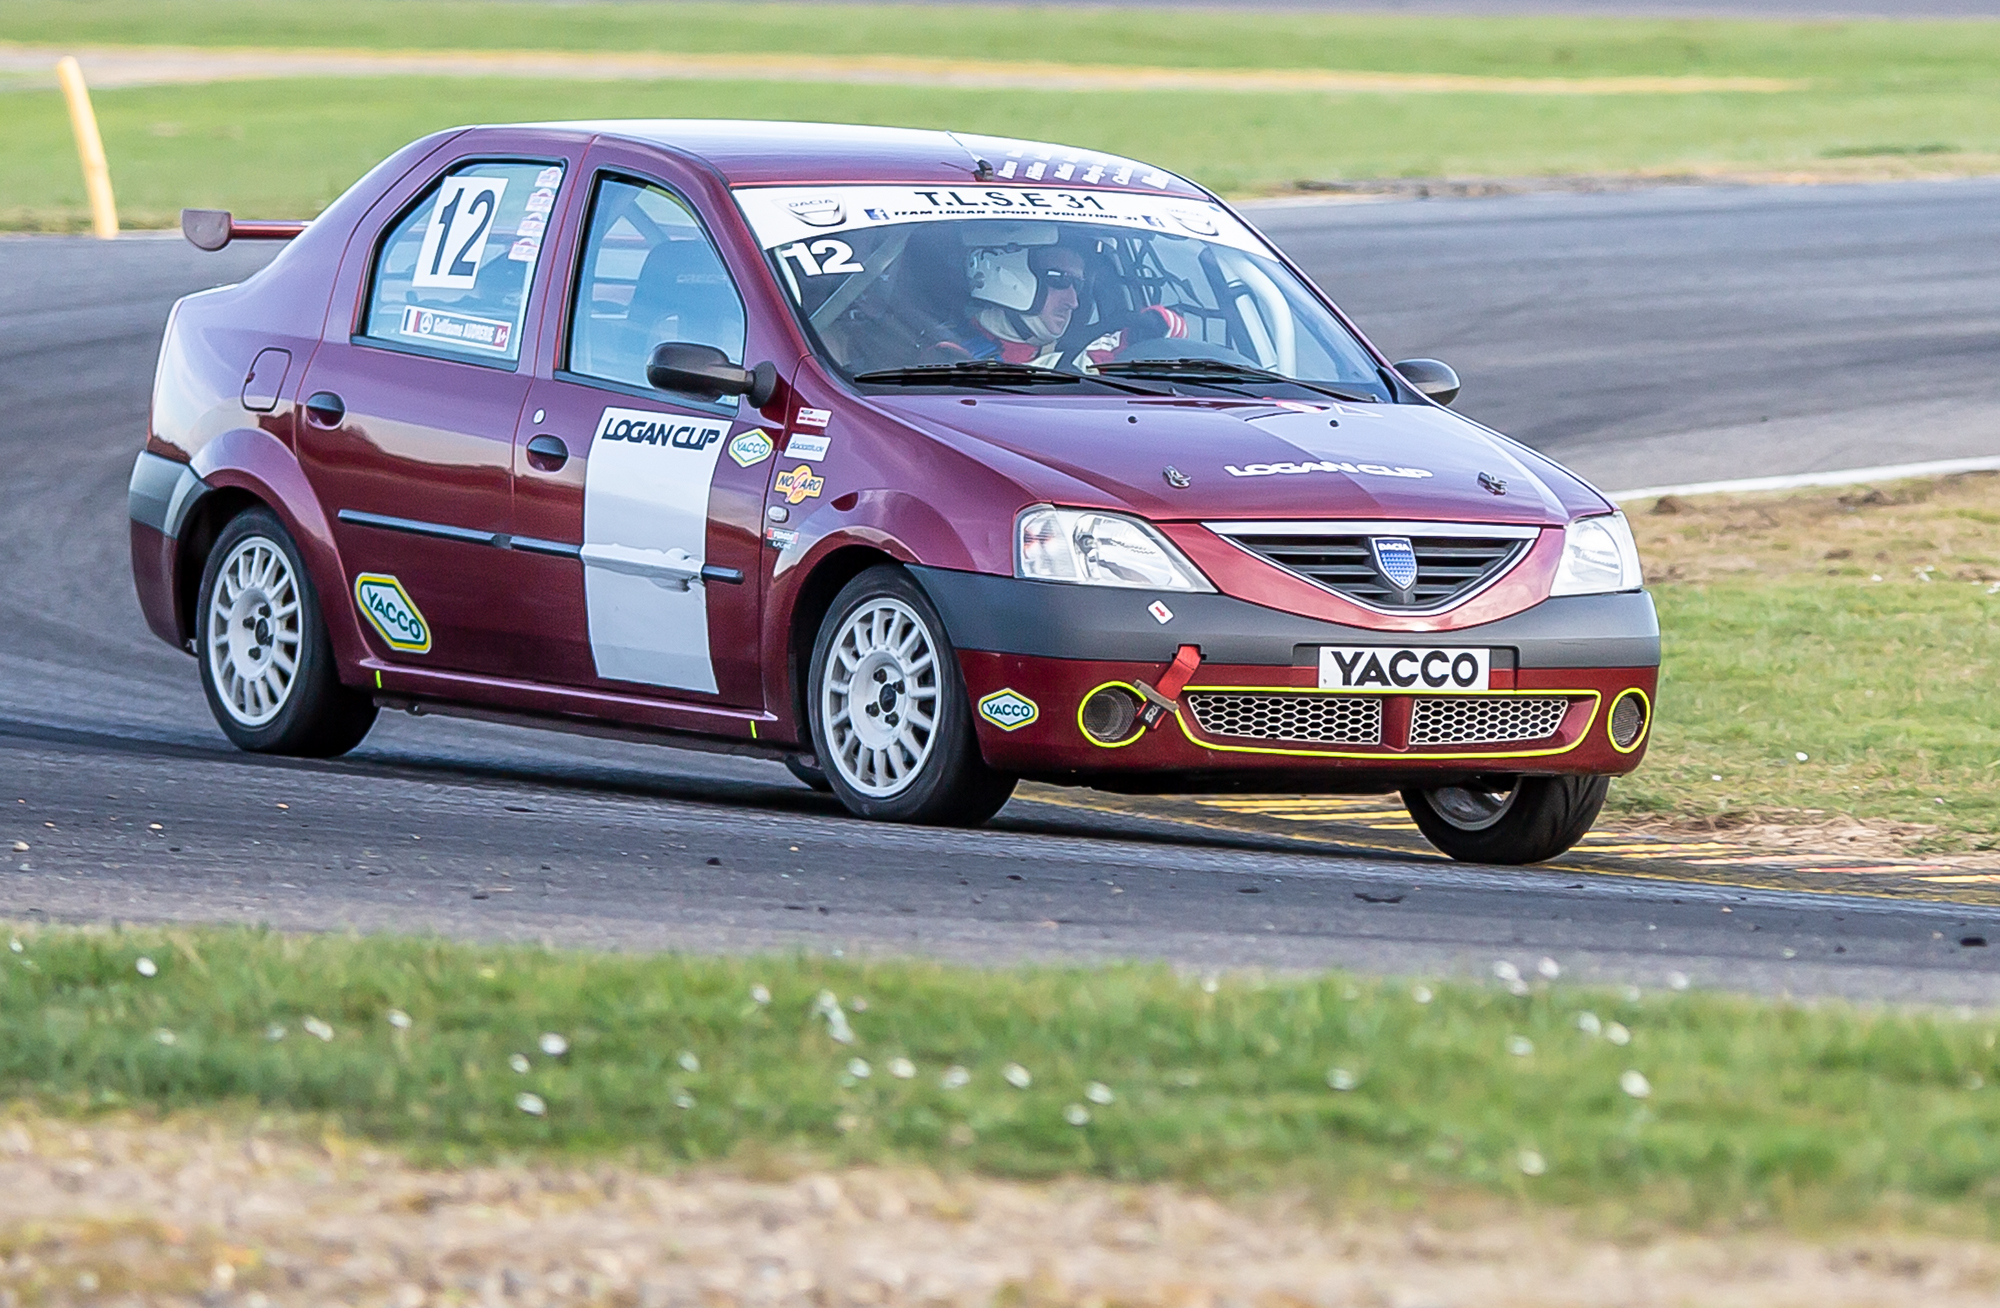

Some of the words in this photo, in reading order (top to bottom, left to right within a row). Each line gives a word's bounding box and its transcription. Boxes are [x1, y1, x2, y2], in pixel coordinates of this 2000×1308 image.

[788, 198, 835, 208] DACIA
[913, 190, 1053, 208] T.L.S.E
[1057, 193, 1105, 211] 31
[430, 187, 496, 277] 12
[782, 239, 865, 277] 12
[601, 417, 676, 447] LOGAN
[671, 426, 721, 451] CUP
[735, 440, 768, 455] YACCO
[1224, 461, 1360, 478] LOGAN
[1356, 463, 1434, 479] CUP
[777, 472, 822, 497] NOGARO
[1377, 542, 1411, 551] DACIA
[366, 586, 422, 640] YACCO
[1331, 650, 1479, 688] YACCO
[986, 703, 1030, 718] YACCO
